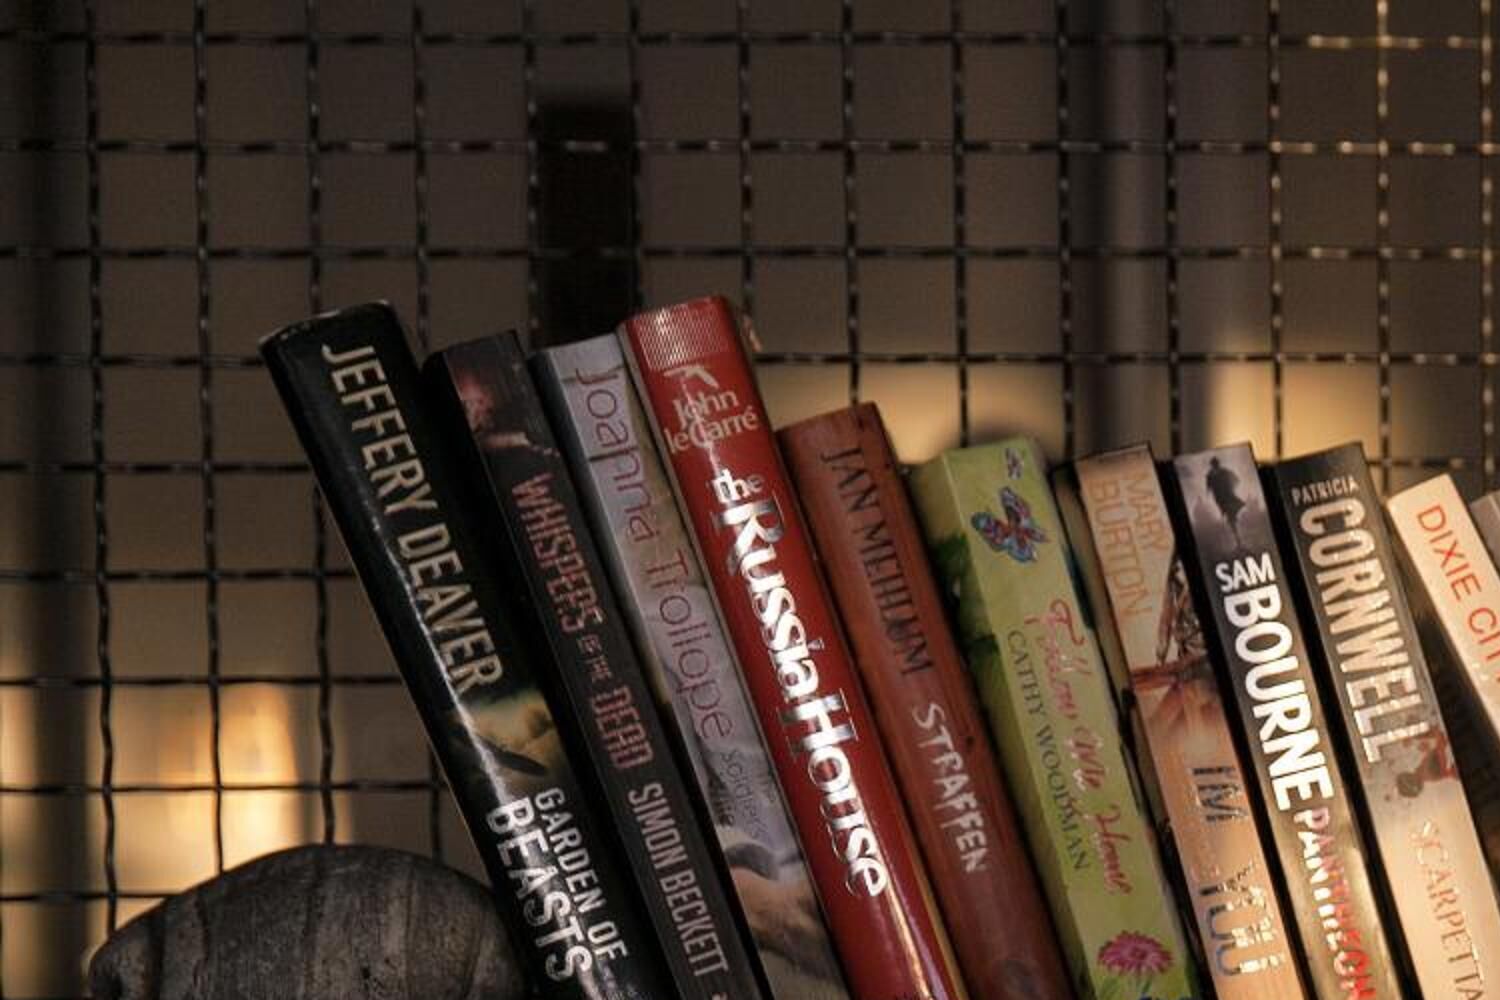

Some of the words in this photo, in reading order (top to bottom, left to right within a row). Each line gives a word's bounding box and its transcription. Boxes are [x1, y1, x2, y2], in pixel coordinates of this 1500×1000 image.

[672, 389, 739, 429] John
[1291, 475, 1359, 505] PATRICIA
[321, 344, 438, 515] JEFFERY
[397, 523, 503, 697] DEAVER
[575, 366, 660, 544] Joanna
[645, 550, 733, 739] Trollope
[821, 446, 880, 515] JAN
[853, 521, 935, 675] MEHLUM
[1089, 480, 1153, 617] BURTON
[1125, 471, 1170, 551] MARY
[1215, 552, 1277, 592] SAM
[1416, 505, 1481, 600] DIXIE
[511, 472, 603, 634] WHISPERS
[591, 684, 654, 769] DEAD
[712, 495, 824, 702] Russia
[777, 688, 888, 897] House
[1224, 583, 1334, 811] BOURNE
[1300, 498, 1430, 763] CORNWELL
[911, 702, 989, 874] STRAFFEN
[1007, 630, 1046, 716] CATHY
[1036, 725, 1090, 872] WOODMAN
[486, 797, 593, 981] BEASTS
[534, 787, 606, 913] GARDEN
[587, 921, 627, 960] OF
[628, 782, 689, 869] SIMON
[660, 867, 729, 977] BECKETT
